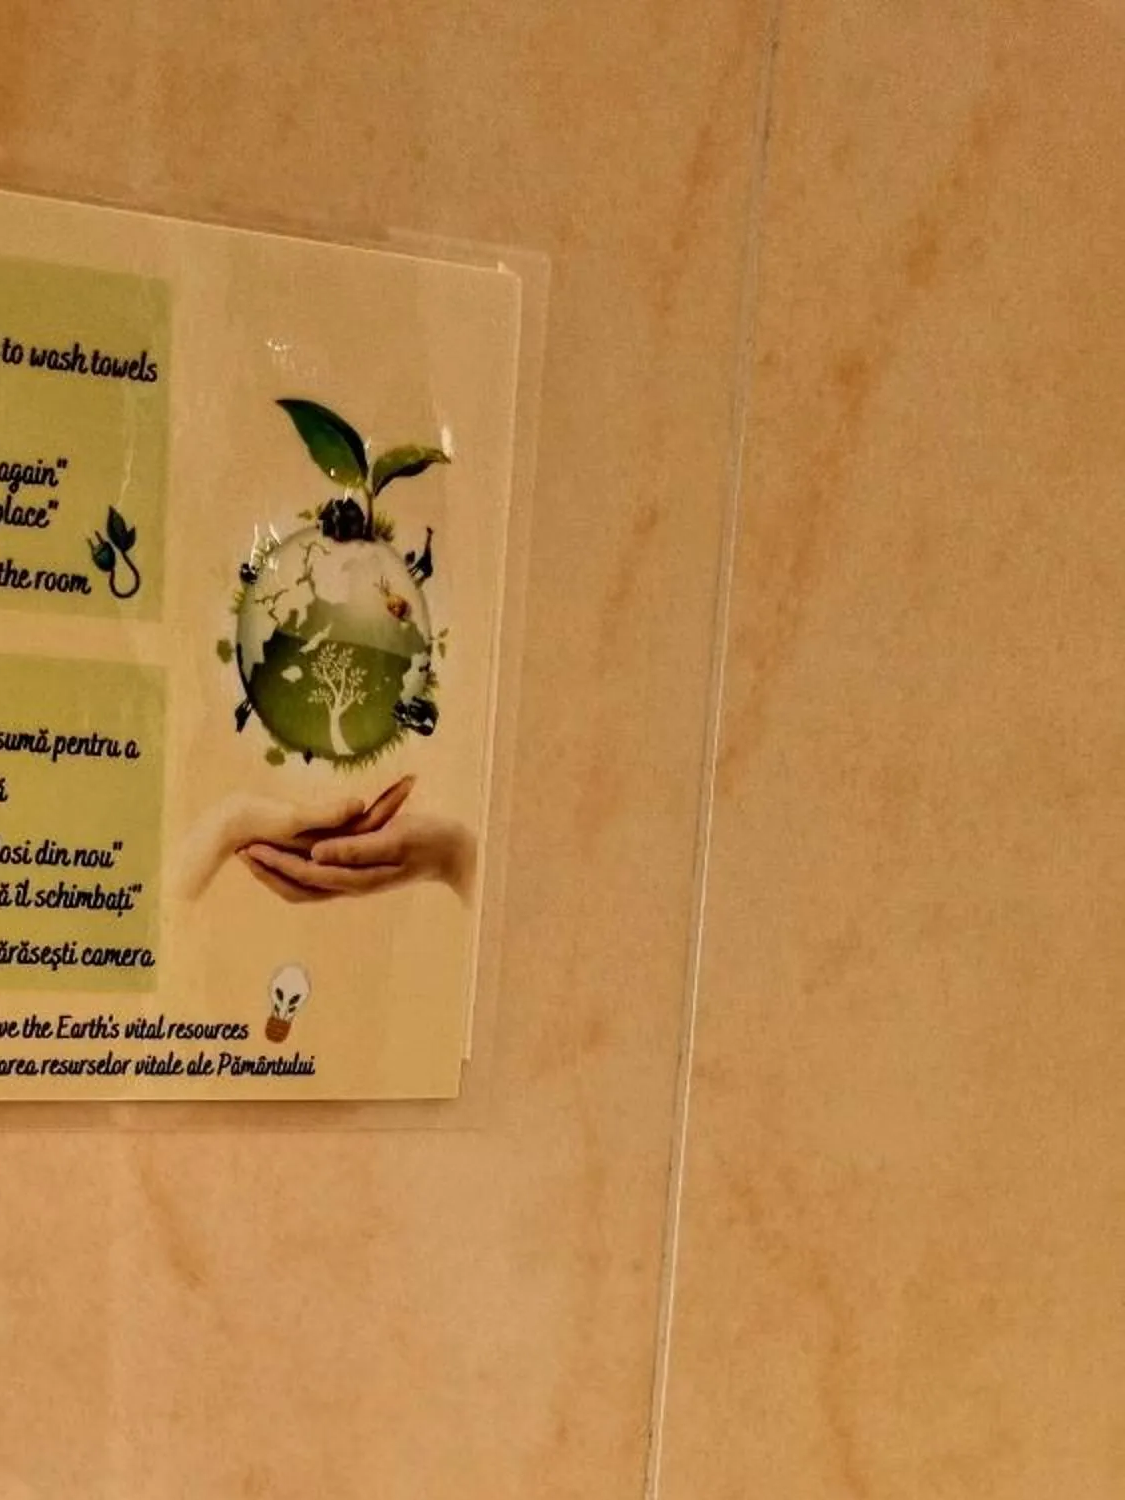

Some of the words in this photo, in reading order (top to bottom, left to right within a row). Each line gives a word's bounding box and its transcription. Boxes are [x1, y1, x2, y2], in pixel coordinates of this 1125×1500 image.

[2, 338, 24, 365] to
[30, 343, 87, 373] wash
[91, 351, 157, 382] towels
[34, 570, 92, 596] room
[53, 733, 122, 762] pentru
[124, 741, 140, 759] a
[34, 840, 70, 867] din
[74, 841, 123, 868] nou"
[13, 880, 32, 907] îl
[81, 944, 156, 967] camera
[22, 1015, 53, 1039] the
[56, 1015, 120, 1040] Earth's
[125, 1015, 166, 1040] vital
[167, 1020, 249, 1040] resources
[39, 1050, 132, 1075] resurselor
[135, 1052, 184, 1076] vitale
[187, 1054, 214, 1076] ale
[217, 1052, 316, 1077] Pământului
